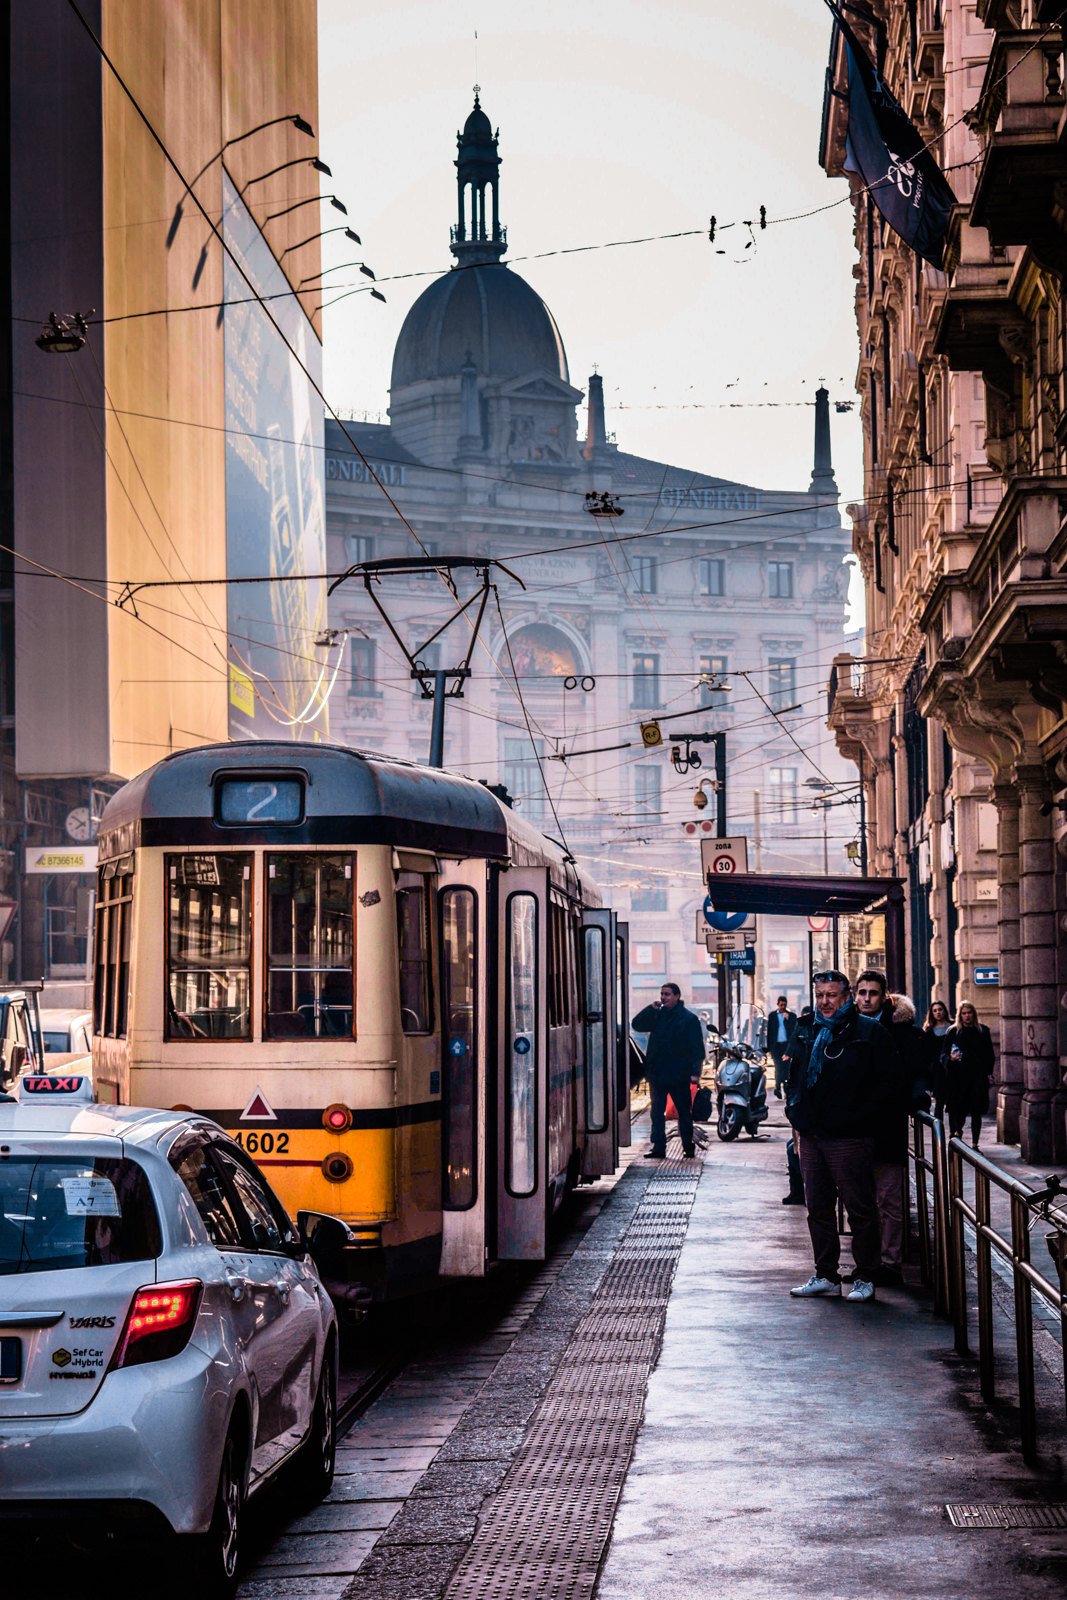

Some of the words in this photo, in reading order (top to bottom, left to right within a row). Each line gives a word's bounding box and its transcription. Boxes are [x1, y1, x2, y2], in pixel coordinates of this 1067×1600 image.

[326, 459, 406, 486] ENERALI
[660, 487, 760, 511] GENERALI
[522, 568, 564, 579] GENERALI
[247, 782, 278, 821] 2
[47, 856, 84, 865] 87366145
[718, 861, 730, 871] 30
[25, 1078, 79, 1090] TAXI
[235, 1132, 289, 1153] 4602
[69, 1315, 116, 1329] YARIS
[73, 1348, 87, 1357] Sef
[88, 1348, 104, 1357] Car
